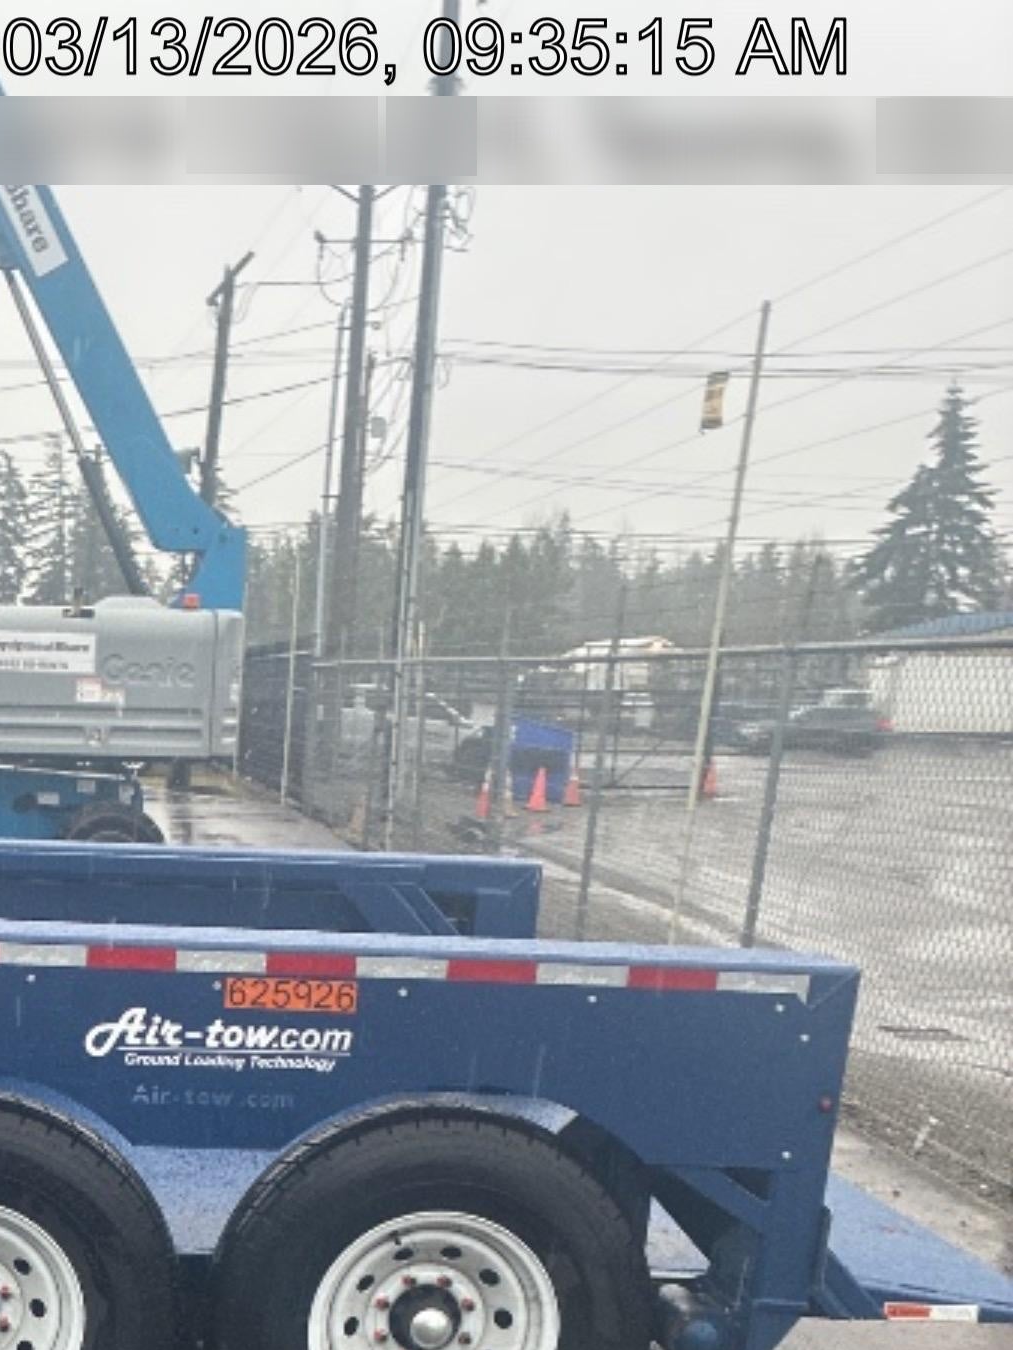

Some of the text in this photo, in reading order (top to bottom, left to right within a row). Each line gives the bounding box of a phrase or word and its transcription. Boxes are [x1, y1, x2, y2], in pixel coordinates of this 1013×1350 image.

[228, 979, 355, 1012] 625926
[85, 1006, 353, 1057] Air-tow.com
[124, 1051, 336, 1072] Ground Loading Technology
